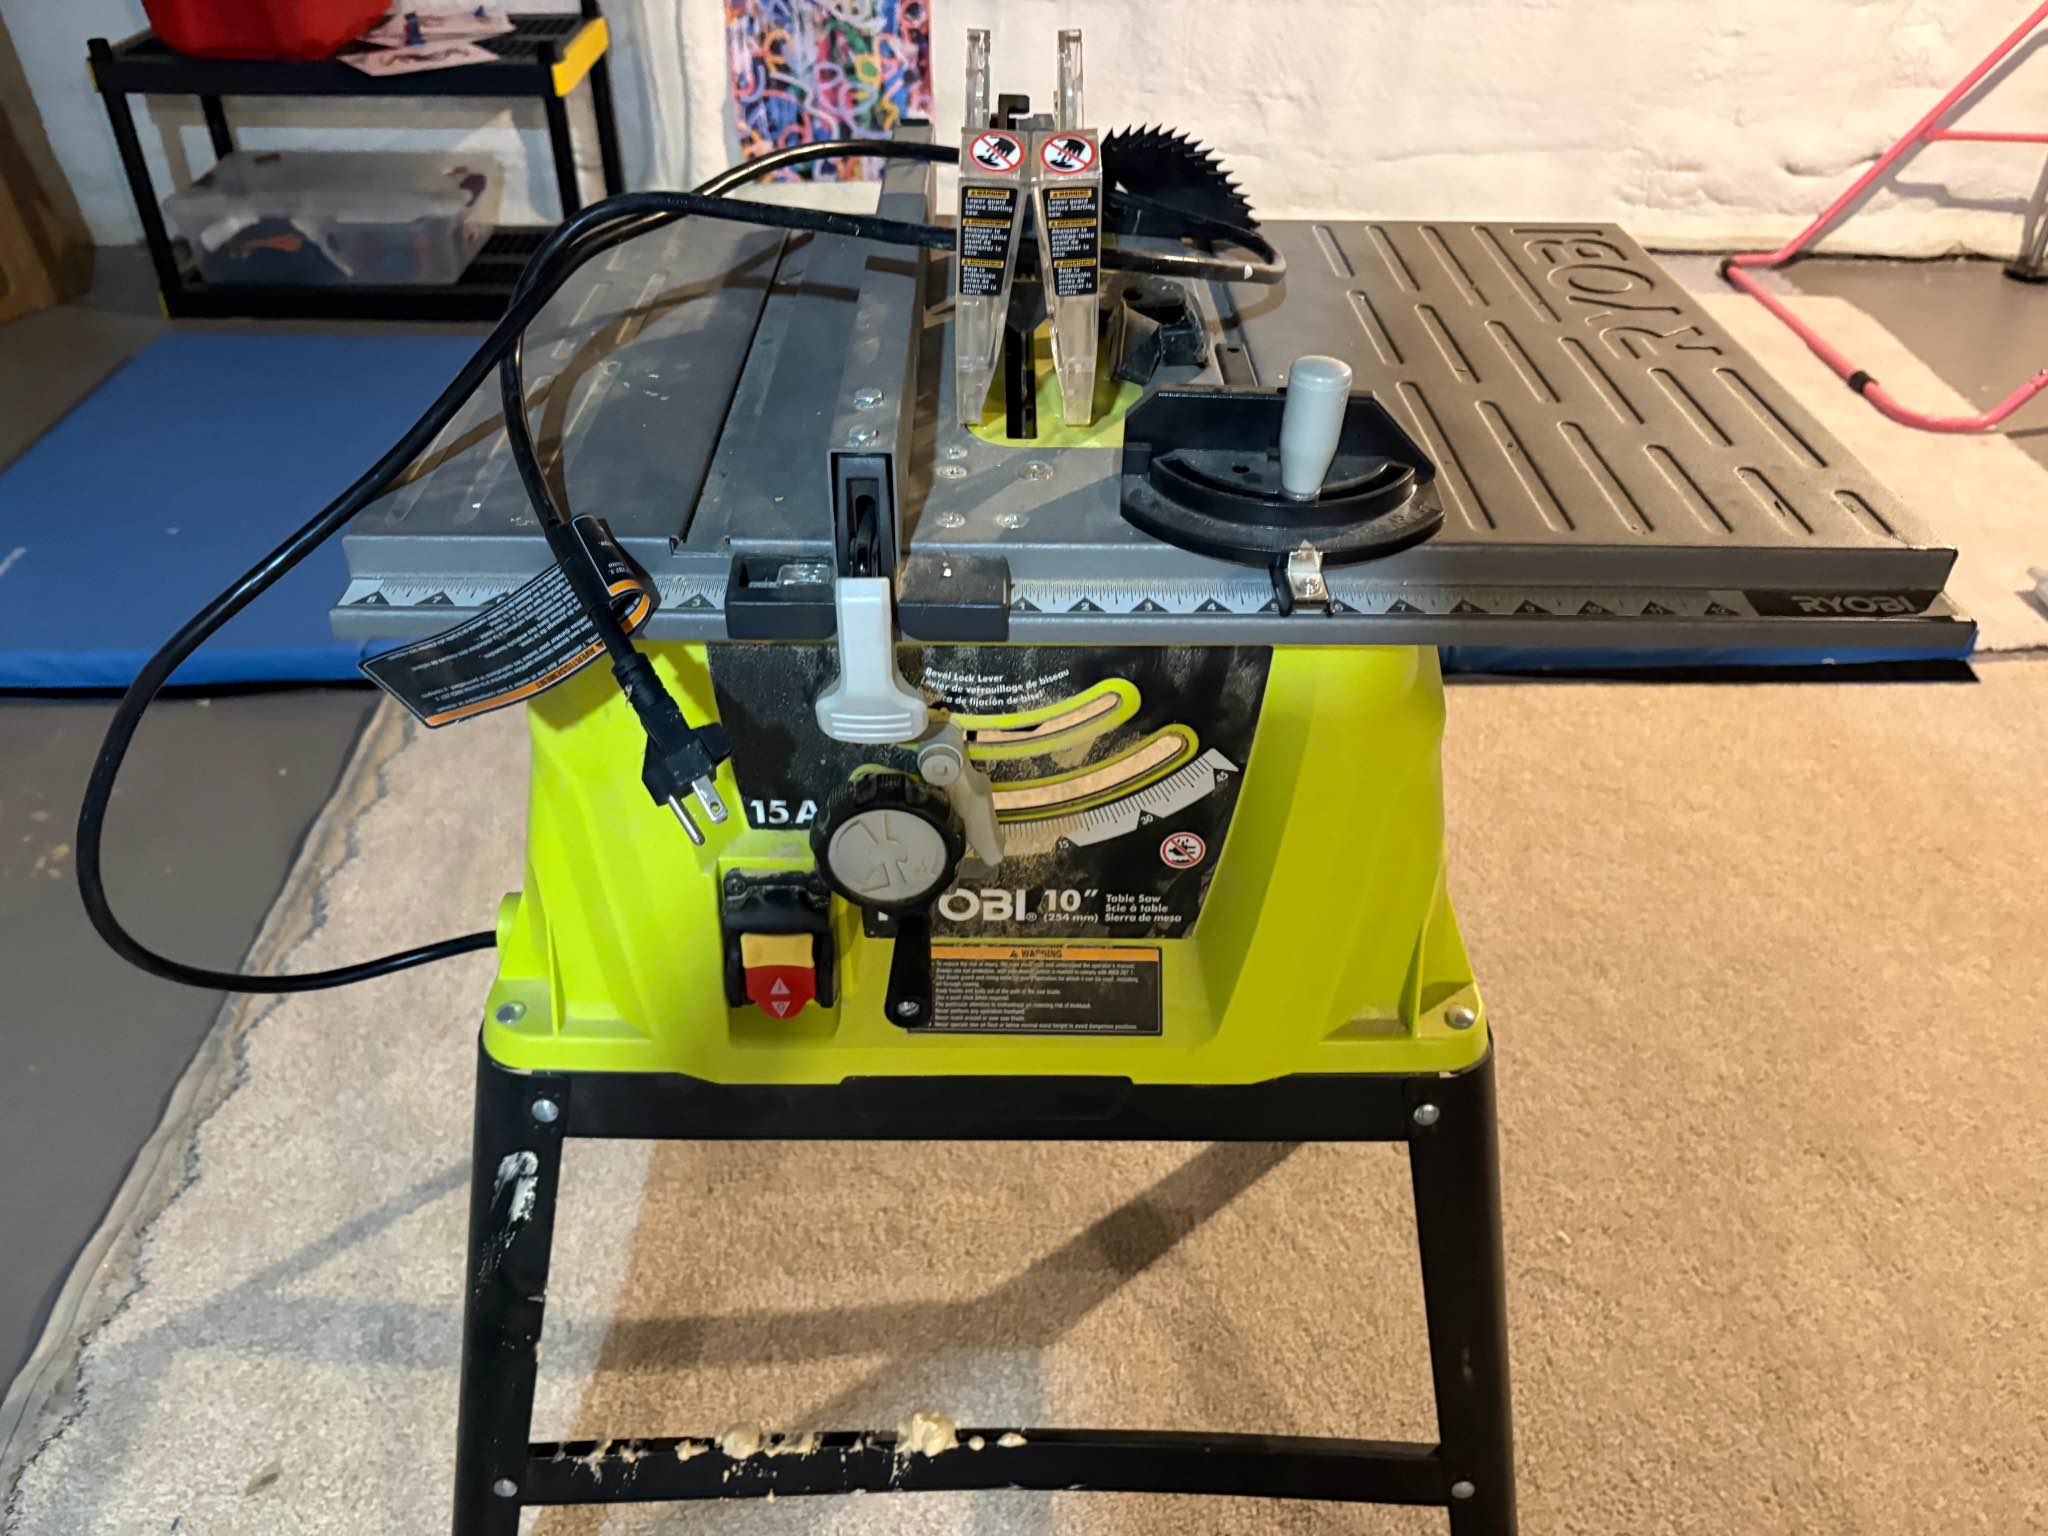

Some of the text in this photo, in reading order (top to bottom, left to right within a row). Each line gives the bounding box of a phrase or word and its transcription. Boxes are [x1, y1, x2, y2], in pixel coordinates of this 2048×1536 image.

[1511, 228, 1724, 360] RYOBI
[1080, 602, 1090, 611] 2
[1144, 602, 1153, 611] 3
[1207, 602, 1216, 611] 4
[1397, 603, 1406, 611] 7
[1791, 595, 1917, 613] RYOBI
[925, 667, 1003, 683] Bevel Lock Lever
[951, 683, 963, 693] de
[966, 683, 1023, 695] verrouillage
[1026, 680, 1038, 689] de
[1039, 668, 1070, 686] biseau
[955, 695, 967, 705] de
[969, 696, 1004, 707] fijación
[1007, 694, 1019, 704] de
[1216, 771, 1229, 783] 45
[750, 799, 790, 824] 15
[1140, 814, 1154, 825] 30
[1058, 841, 1069, 849] 15
[1106, 893, 1161, 904] Table Saw
[1105, 902, 1169, 912] Scie à table
[1043, 913, 1099, 925] (254 mm)
[1104, 913, 1182, 923] Sierra de mesa
[1020, 949, 1062, 958] WARNING
